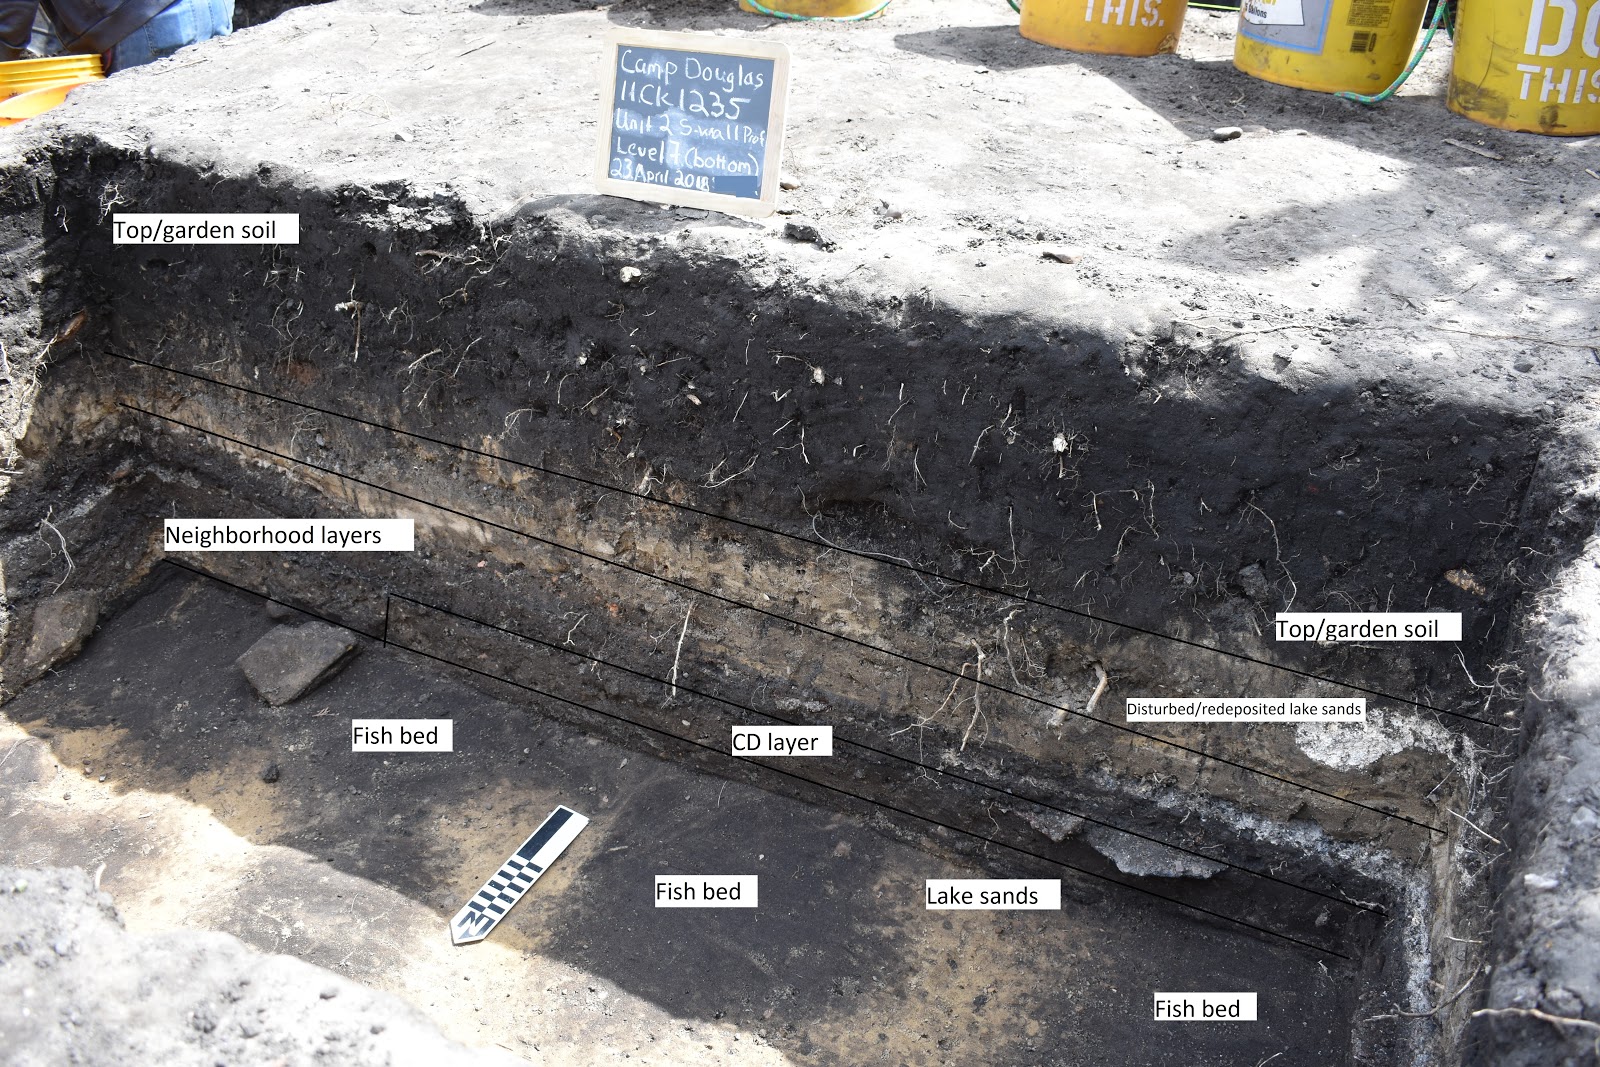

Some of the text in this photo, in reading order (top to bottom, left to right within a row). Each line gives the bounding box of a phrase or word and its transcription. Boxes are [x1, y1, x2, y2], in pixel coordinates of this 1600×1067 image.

[620, 49, 764, 93] Camp Douglas
[615, 107, 652, 134] Unit
[659, 114, 674, 136] 2
[743, 125, 767, 147] Prof
[616, 136, 760, 177] Level 7 (bottom)
[633, 162, 669, 184] April
